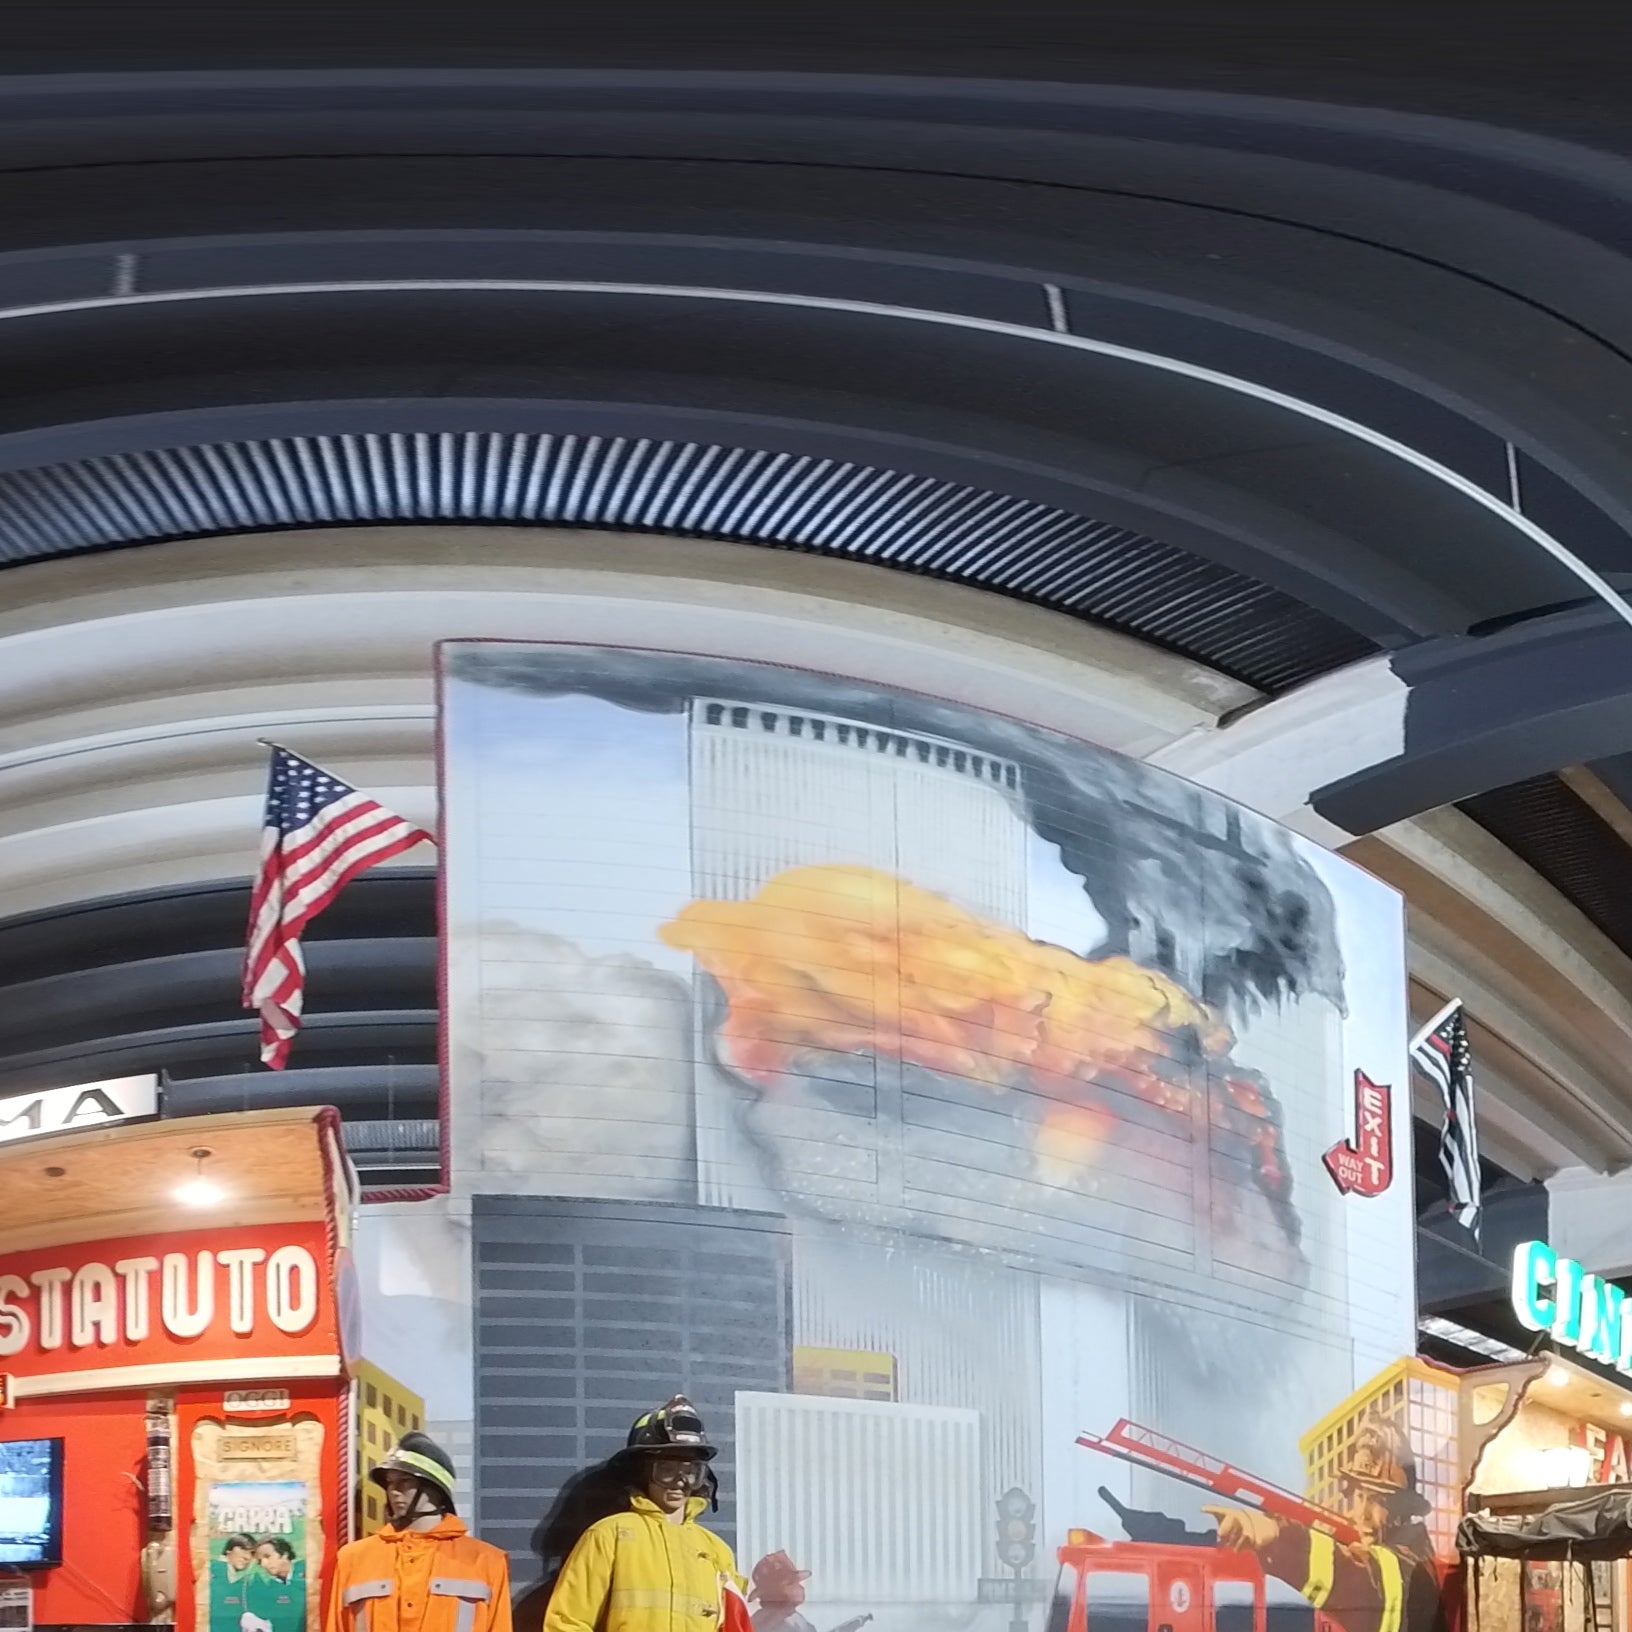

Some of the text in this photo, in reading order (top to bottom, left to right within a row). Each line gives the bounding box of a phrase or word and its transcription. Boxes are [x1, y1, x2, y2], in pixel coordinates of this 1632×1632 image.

[1363, 1087, 1385, 1185] EXIT
[1338, 1153, 1363, 1172] WAY
[1338, 1166, 1363, 1184] OUT
[226, 1390, 287, 1408] OGGI
[223, 1440, 292, 1453] SIGNORE
